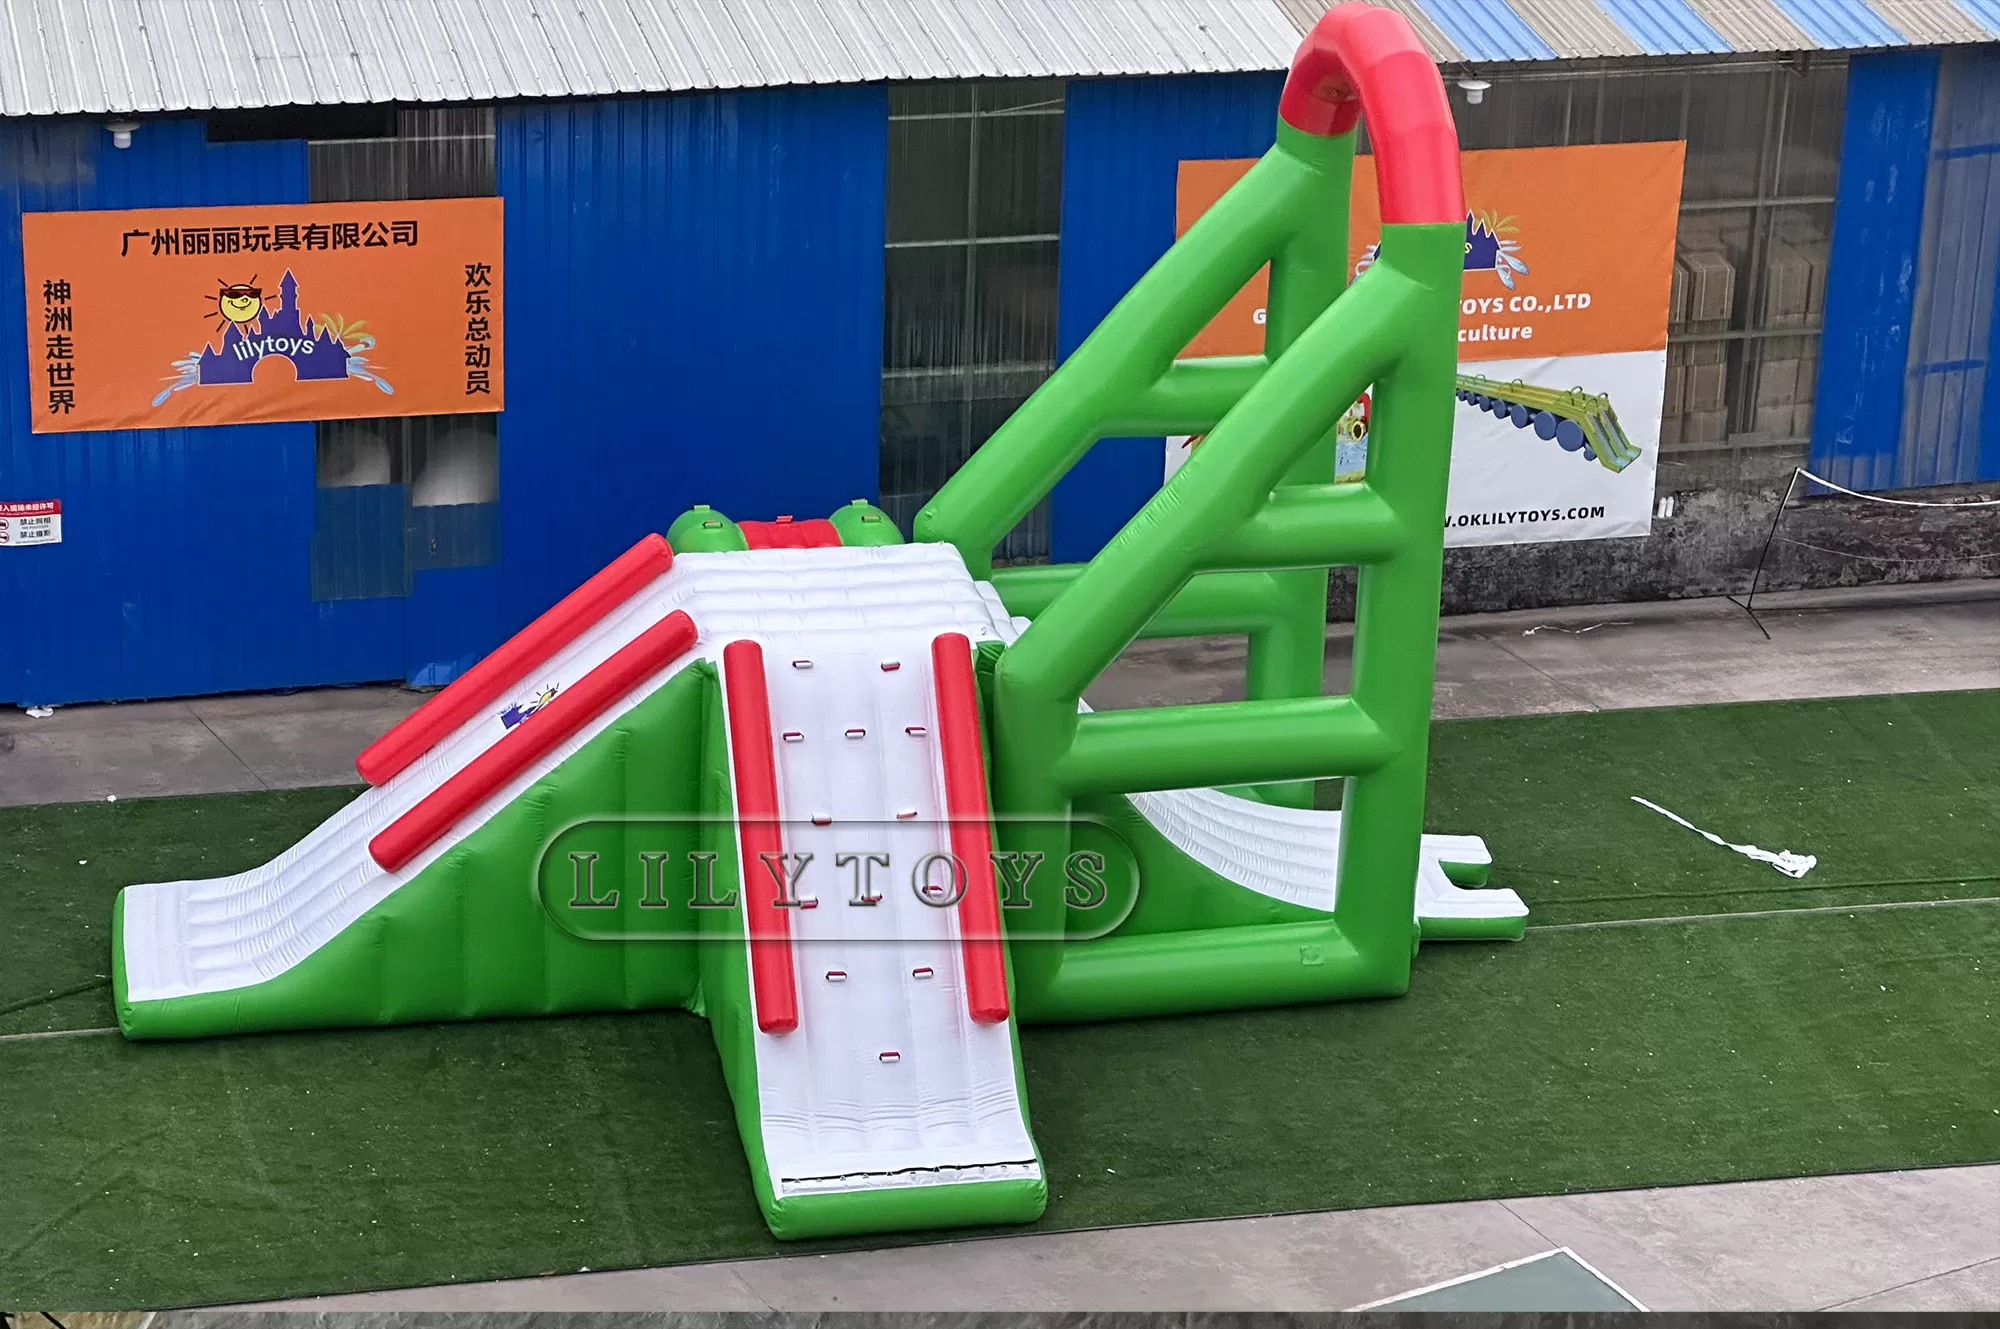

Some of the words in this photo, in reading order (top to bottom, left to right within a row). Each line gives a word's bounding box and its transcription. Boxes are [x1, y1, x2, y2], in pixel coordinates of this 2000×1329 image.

[121, 220, 419, 257] 广州丽丽玩具有限公司
[1459, 297, 1504, 315] OYS
[1509, 293, 1592, 313] CO.,LTD
[43, 279, 76, 415] 神洲走世界
[464, 262, 492, 395] 欢乐总动员
[232, 335, 315, 361] lilytoys
